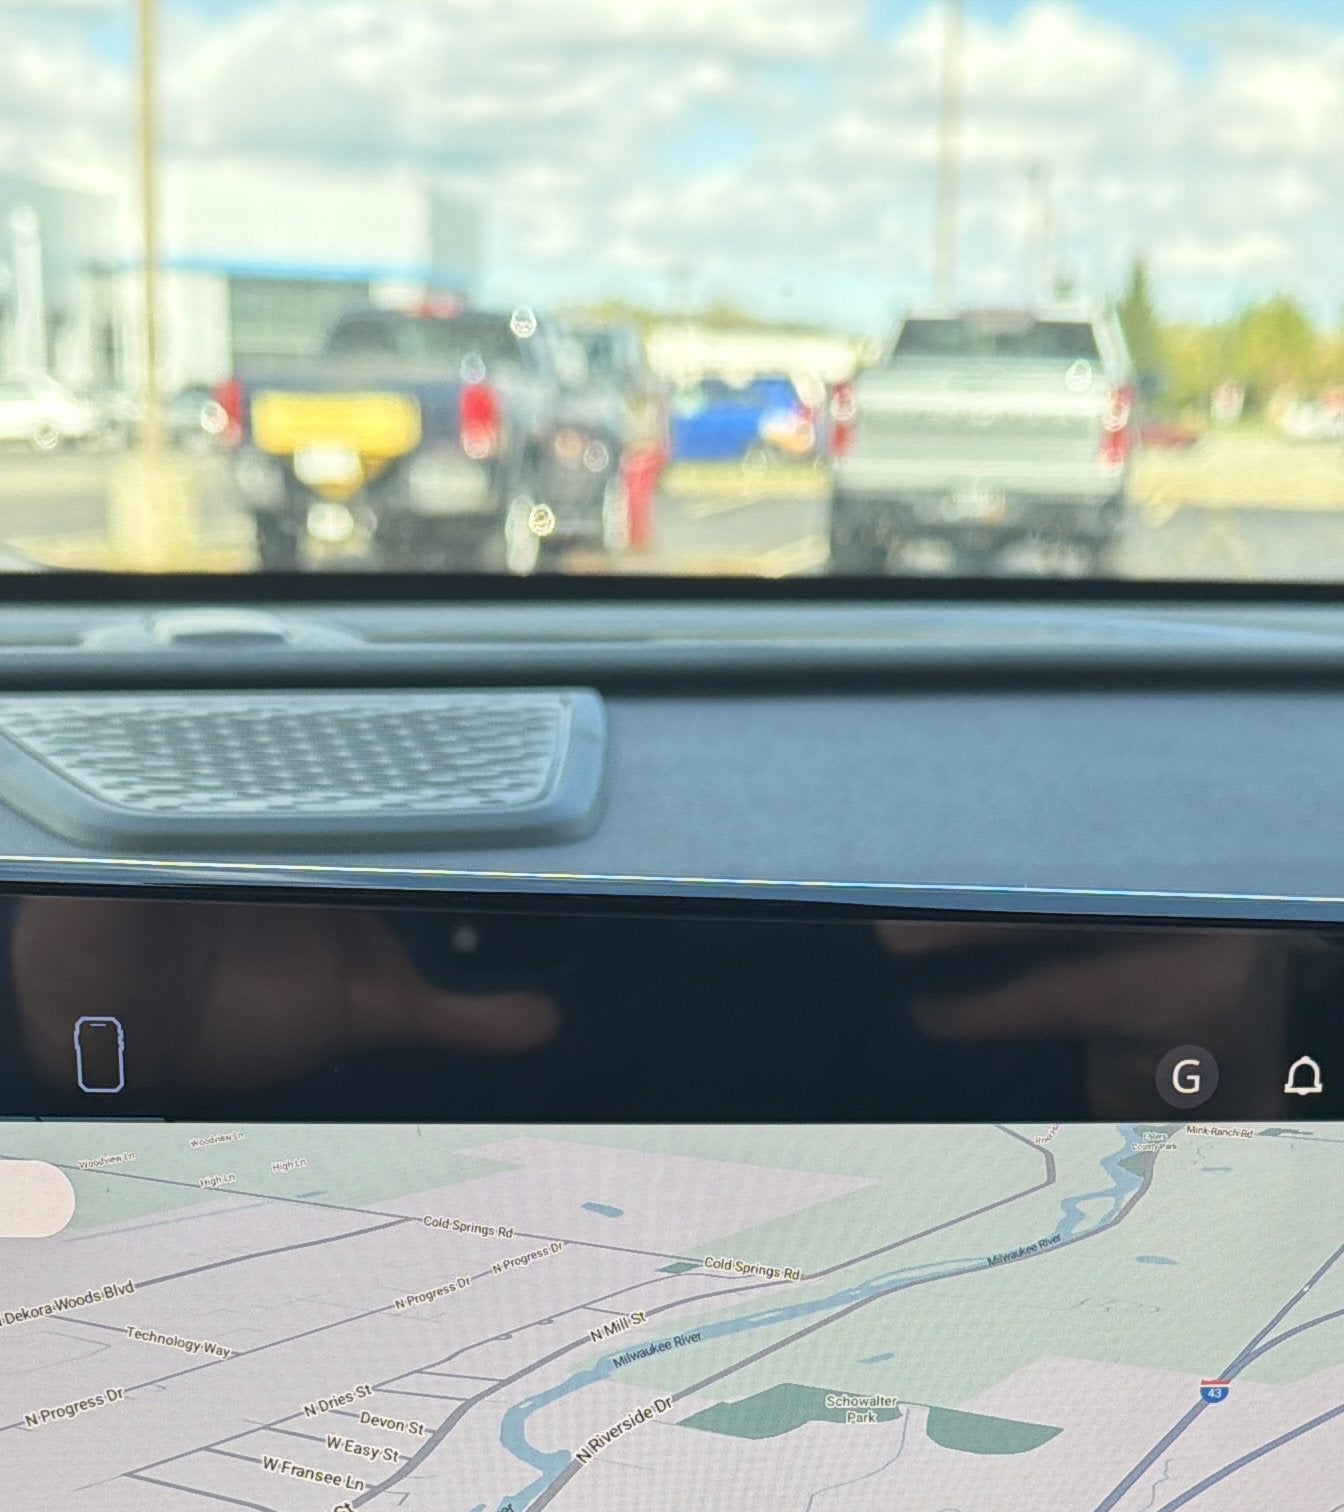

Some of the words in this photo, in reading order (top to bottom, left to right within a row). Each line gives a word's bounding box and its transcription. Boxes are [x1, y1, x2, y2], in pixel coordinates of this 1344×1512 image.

[1186, 1125, 1210, 1136] Mink
[1211, 1127, 1239, 1138] Ranch
[424, 1215, 450, 1230] Cold
[452, 1219, 495, 1238] Springs
[498, 1228, 514, 1239] Rd
[492, 1265, 502, 1274] N
[503, 1248, 549, 1270] Progress
[551, 1243, 563, 1253] Dr
[987, 1244, 1037, 1268] Milwaukee
[1038, 1234, 1061, 1253] River
[704, 1257, 733, 1273] Cold
[735, 1261, 781, 1280] Springs
[784, 1268, 800, 1280] Rd
[5, 1304, 52, 1324] Dekora
[54, 1290, 102, 1311] Woods
[104, 1280, 134, 1299] Blvd
[395, 1299, 405, 1309] N
[406, 1284, 456, 1306] Progress
[457, 1277, 471, 1289] Dr
[126, 1327, 200, 1354] Technology
[203, 1342, 231, 1359] Way
[591, 1328, 603, 1343] N
[604, 1315, 630, 1338] Mill
[631, 1311, 647, 1325] St
[613, 1338, 672, 1368] Milwaukee
[673, 1331, 702, 1350] River
[25, 1414, 39, 1427] N
[40, 1396, 105, 1423] Progress
[106, 1388, 124, 1402] Dr
[304, 1405, 316, 1418] N
[318, 1392, 354, 1413] Dries
[355, 1384, 372, 1399] St
[827, 1395, 897, 1408] Schowalter
[1208, 1388, 1222, 1399] 43
[360, 1412, 404, 1432] Devon
[408, 1421, 425, 1436] St
[576, 1447, 590, 1464] N
[588, 1408, 654, 1455] Riverside
[654, 1396, 672, 1414] Dr
[846, 1411, 876, 1424] Park
[327, 1435, 342, 1449] W
[345, 1440, 379, 1461] Easy
[382, 1448, 399, 1463] St
[262, 1456, 278, 1471] W
[281, 1462, 342, 1486] Fransee
[346, 1477, 364, 1491] Ln
